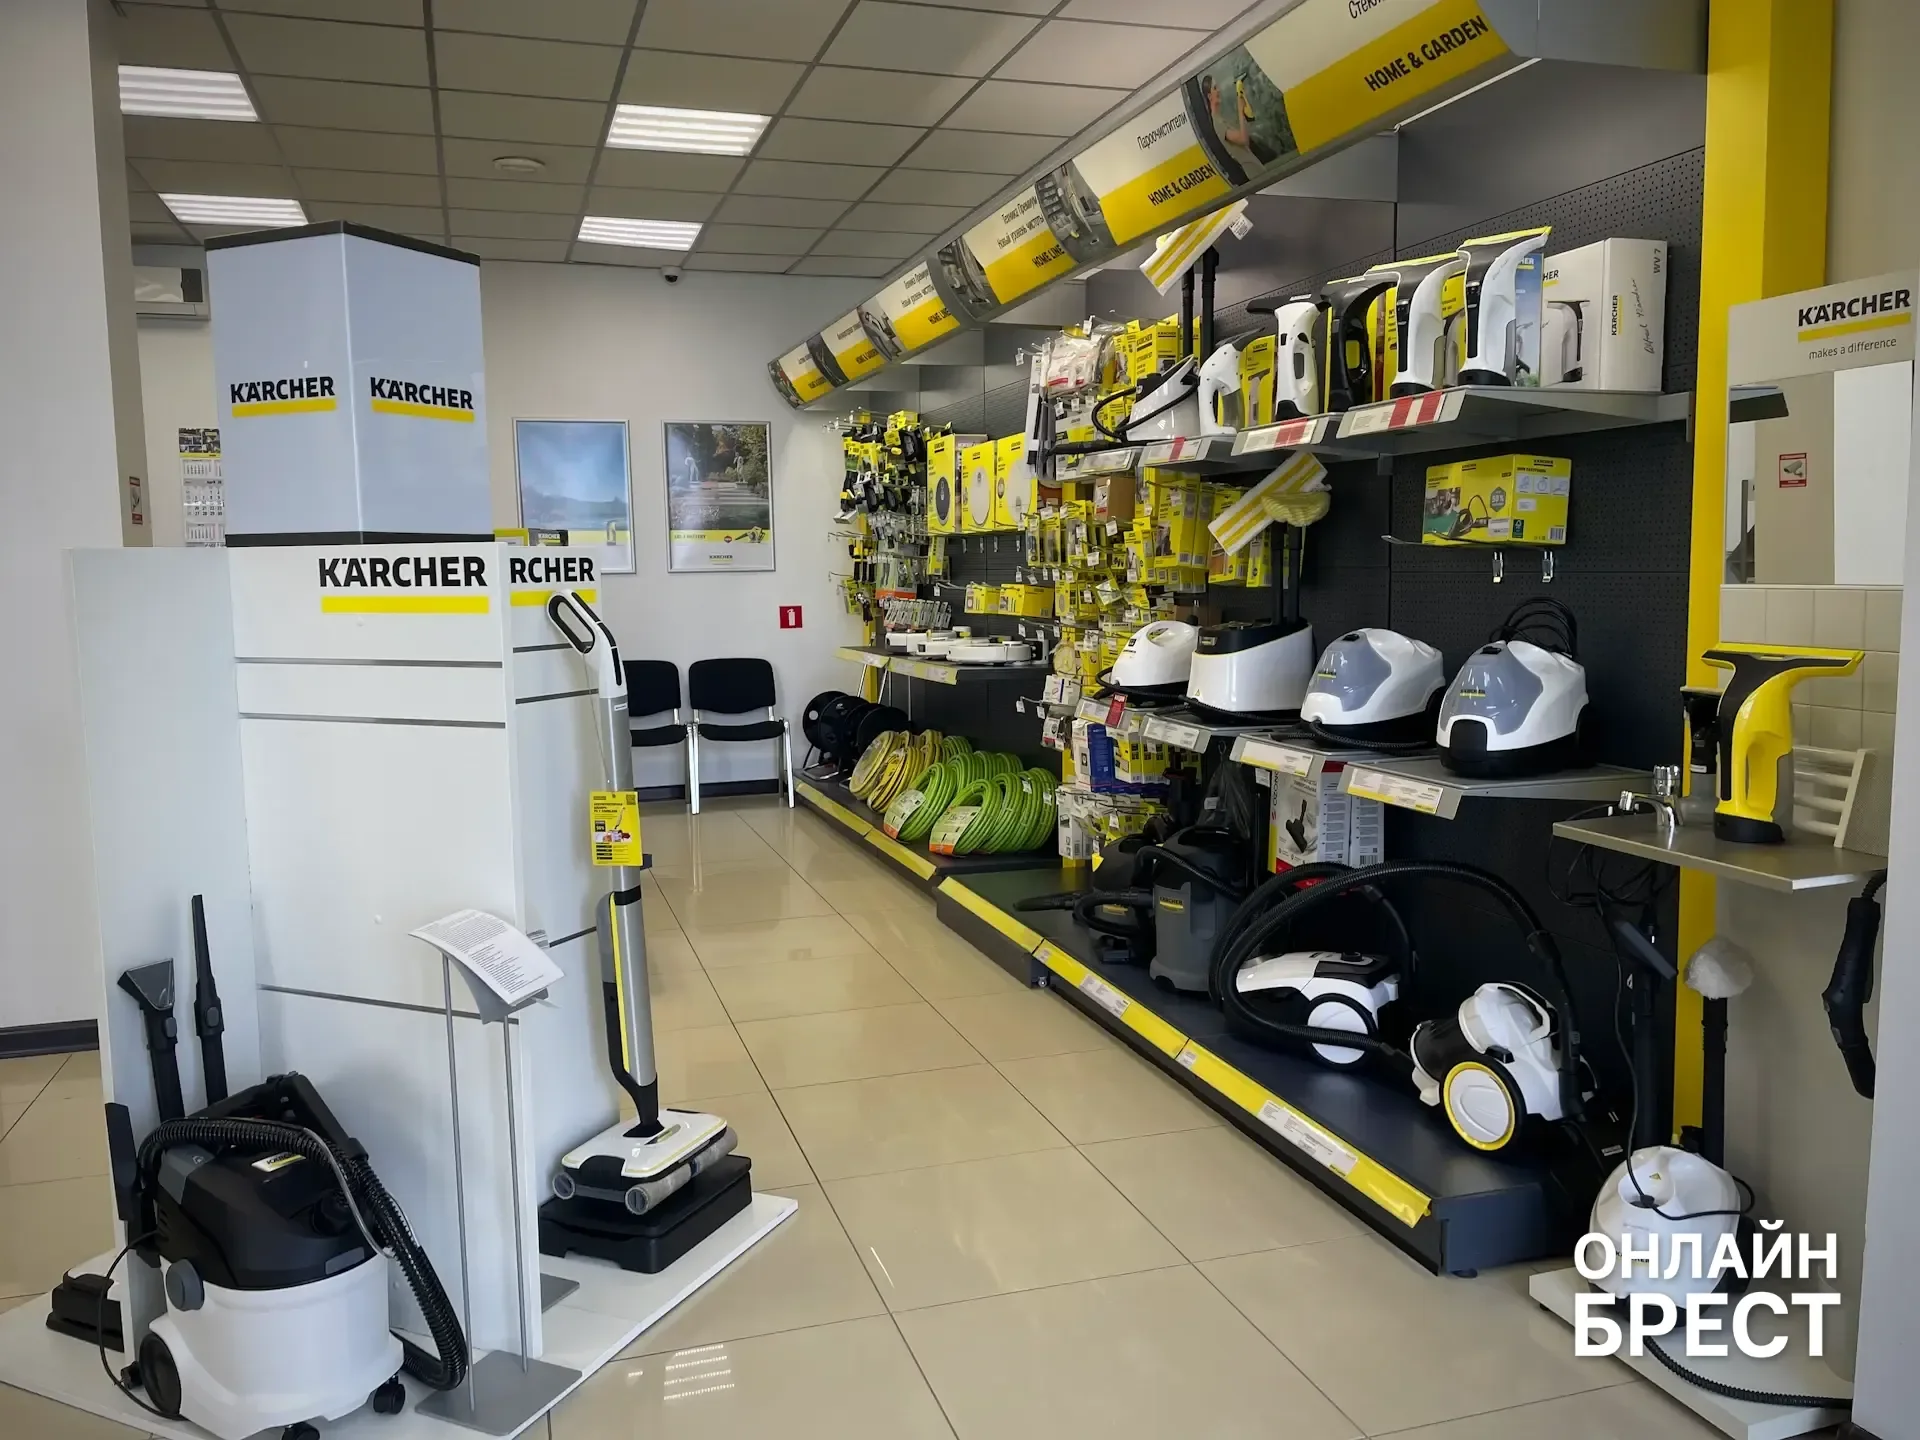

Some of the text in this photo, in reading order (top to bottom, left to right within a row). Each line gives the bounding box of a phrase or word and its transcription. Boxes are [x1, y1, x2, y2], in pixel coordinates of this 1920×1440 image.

[1364, 15, 1489, 91] HOME & GARDEN
[1136, 111, 1188, 151] Пароочистители
[1147, 163, 1216, 207] HOME & GARDEN
[1032, 244, 1066, 268] HOME LINE
[1653, 258, 1661, 274] WV
[1798, 288, 1911, 327] KÄRCHER
[1808, 337, 1897, 360] makes a difference
[230, 376, 336, 404] KÄRCHER
[369, 376, 474, 410] KÄRCHER
[318, 556, 488, 588] KÄRCHER
[509, 557, 596, 584] RCHER
